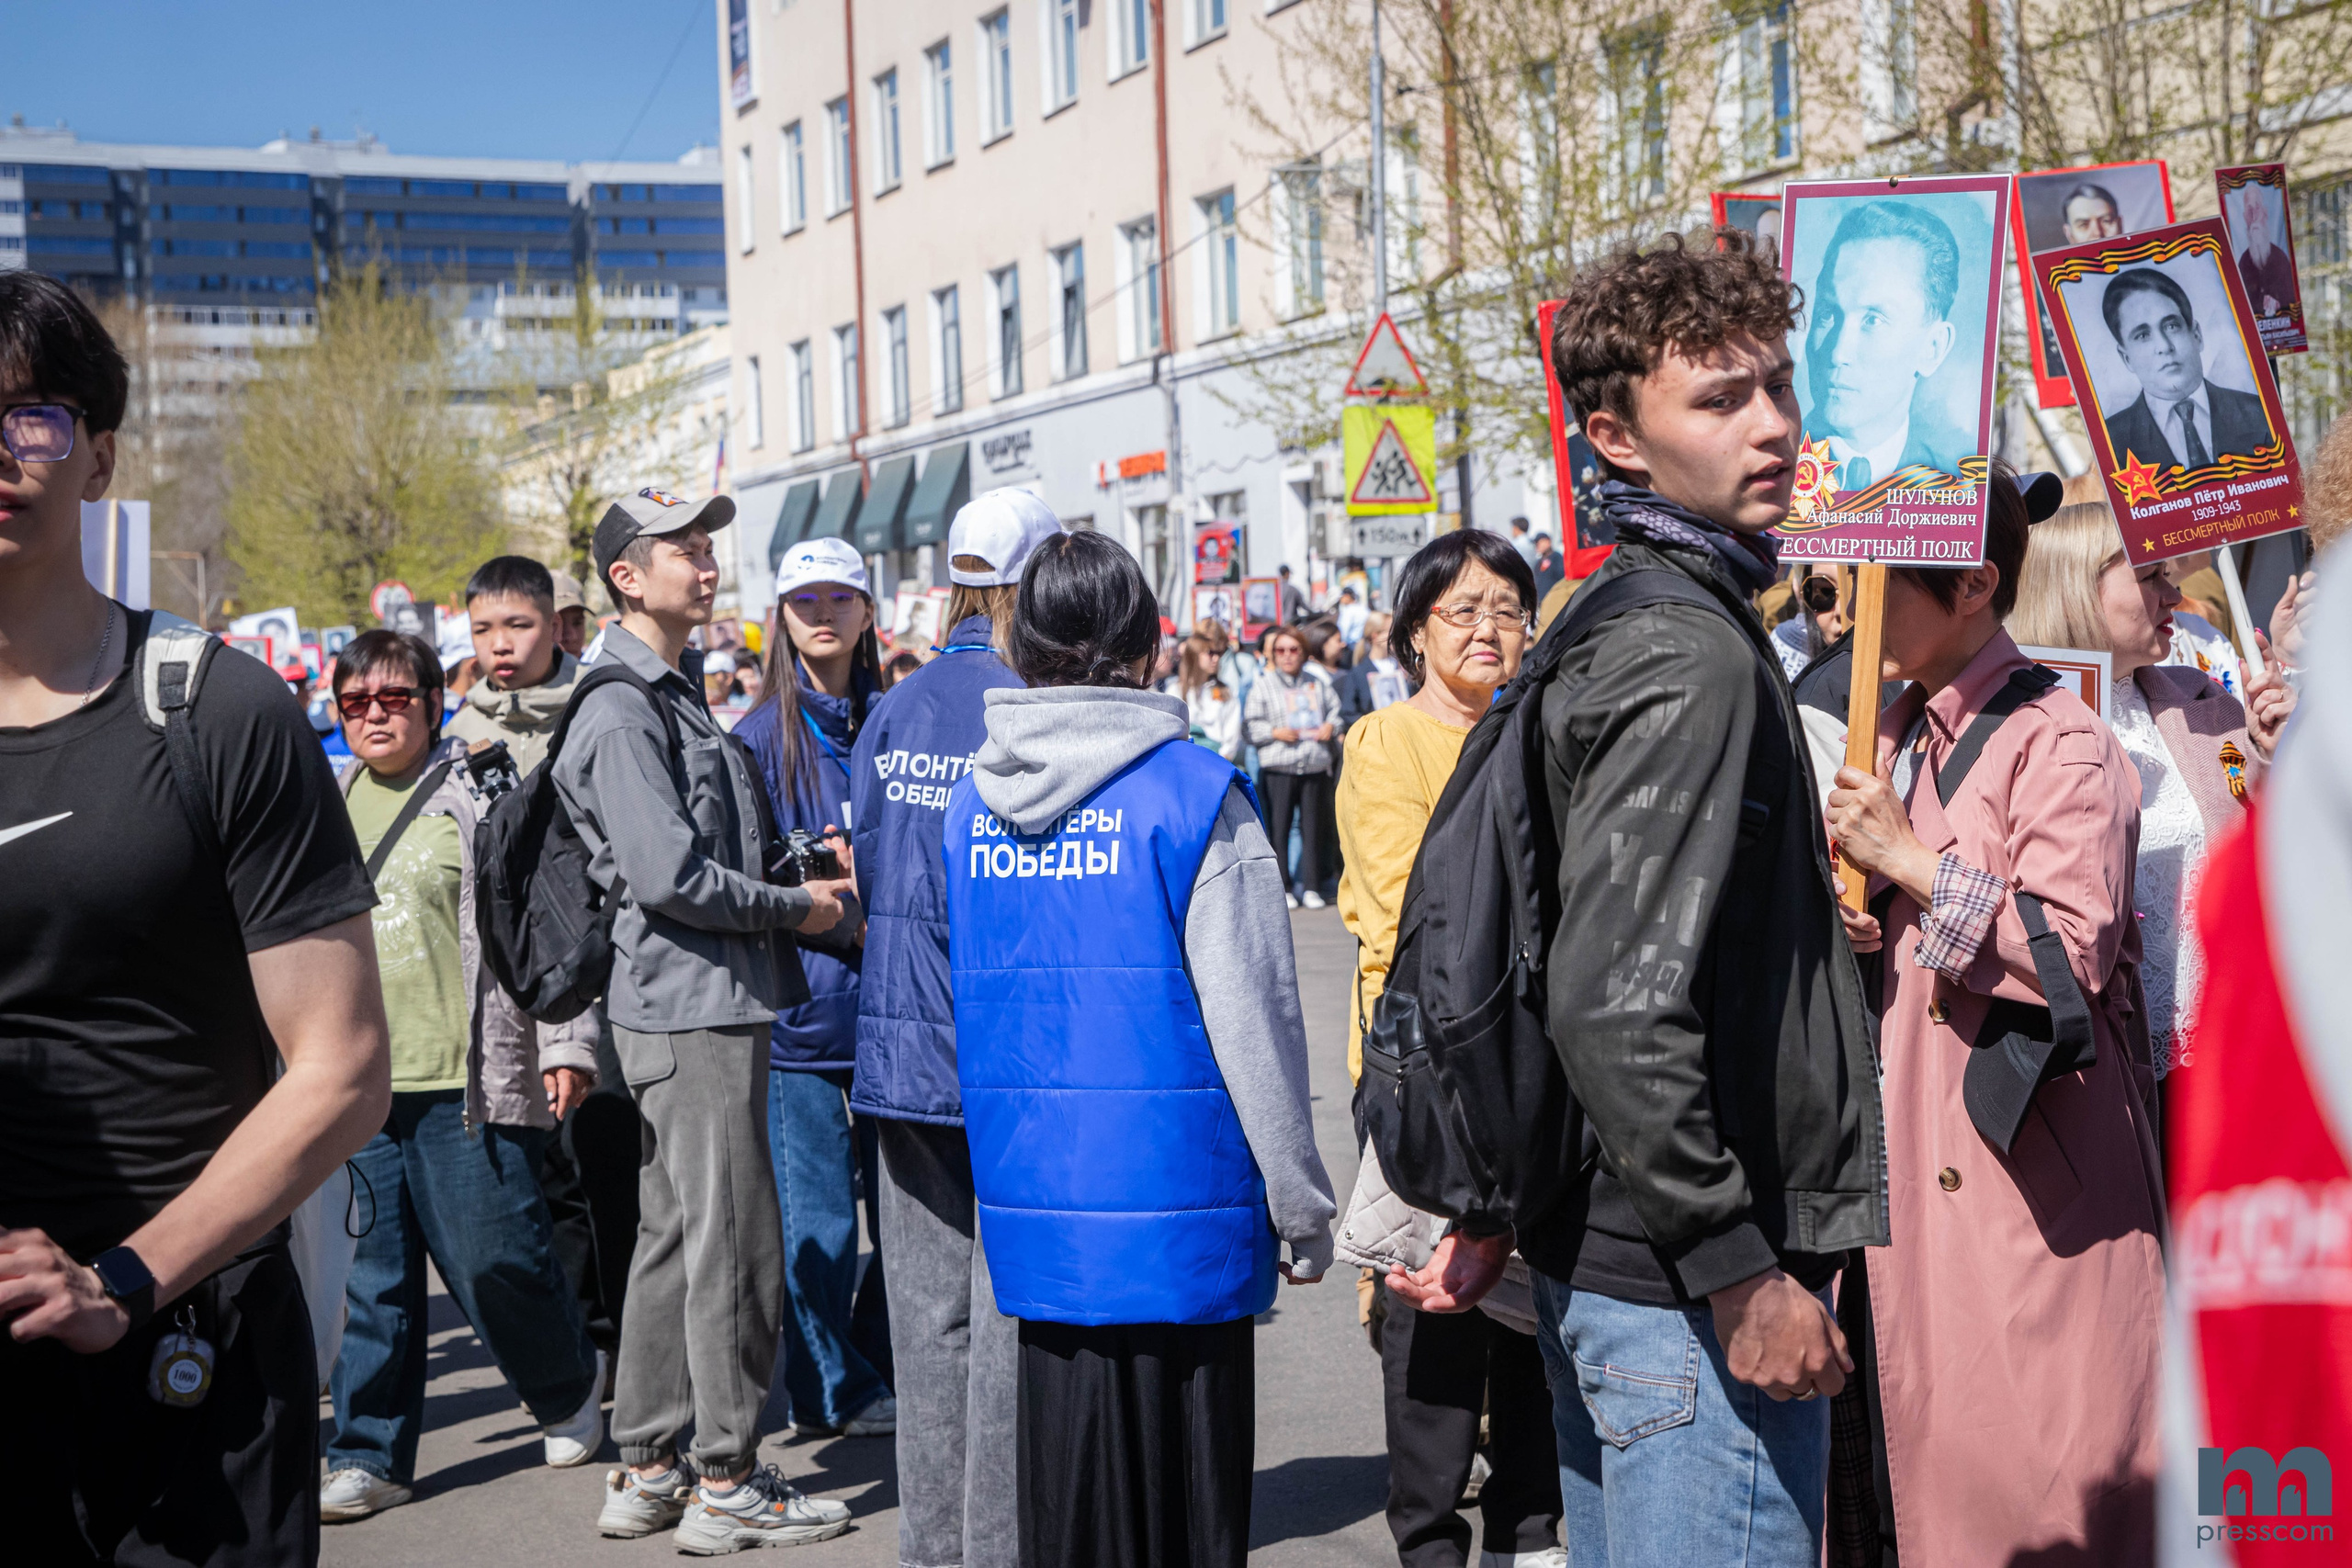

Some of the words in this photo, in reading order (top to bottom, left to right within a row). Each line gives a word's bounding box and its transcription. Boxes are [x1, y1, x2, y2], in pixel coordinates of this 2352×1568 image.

[1885, 488, 1978, 506] ШУЛУНОВ
[2130, 497, 2193, 520] Колганов
[2194, 489, 2225, 505] Пётр
[2227, 474, 2290, 497] Иванович
[1805, 507, 1883, 527] Афанасий
[1887, 508, 1977, 529] Доржиевич
[2191, 500, 2242, 522] 1909-1943
[2162, 514, 2246, 547] БЕССМЕРТНЫЙ
[2247, 508, 2281, 526] ПОЛК
[1921, 540, 1974, 558] ПОЛК
[886, 781, 953, 811] ОБЕД
[970, 840, 1120, 880] ПОБЕДЫ
[174, 1369, 197, 1383] 1000
